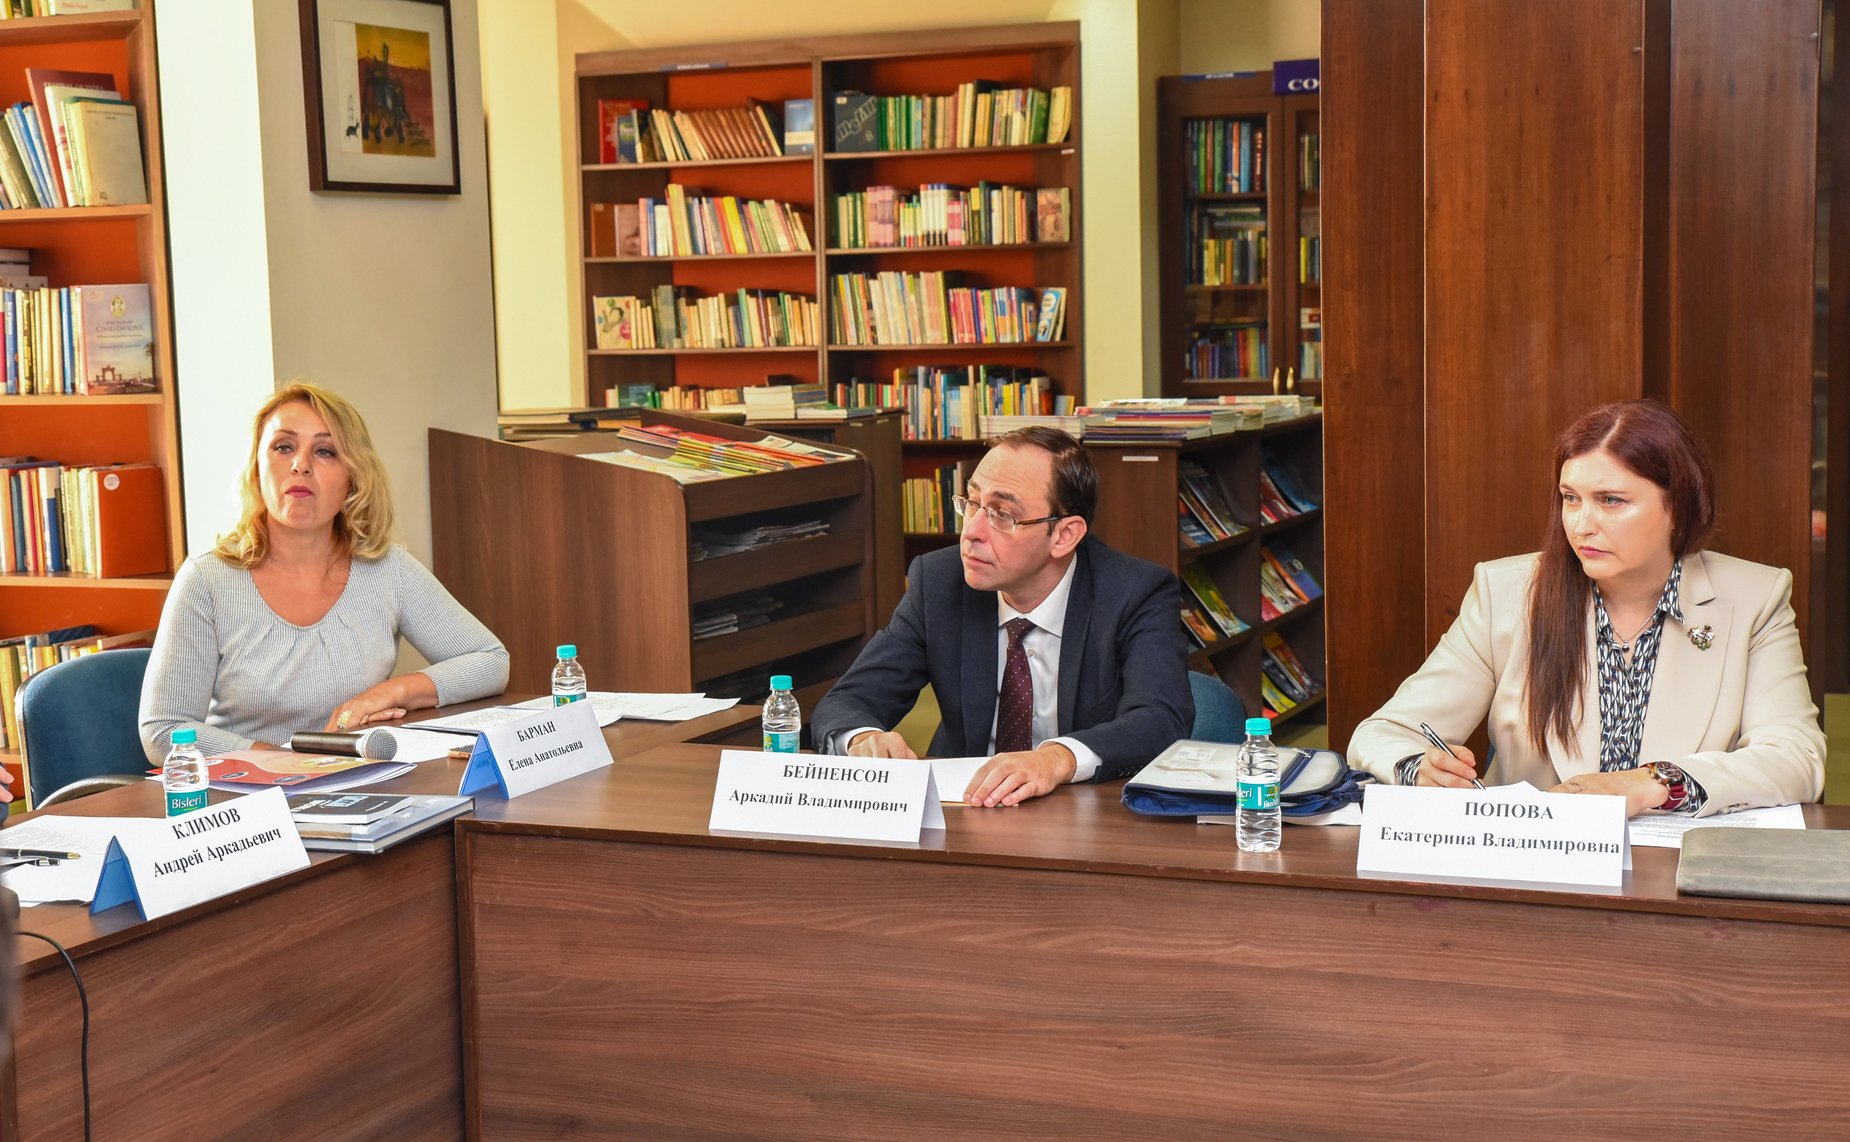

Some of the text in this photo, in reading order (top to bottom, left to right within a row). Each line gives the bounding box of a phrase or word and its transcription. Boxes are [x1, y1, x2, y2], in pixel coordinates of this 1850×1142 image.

[516, 721, 556, 742] БАРМАН
[508, 739, 584, 771] Елена Анатольевна
[783, 763, 890, 784] БЕЙНЕНСОН
[171, 795, 203, 809] Bisleri
[729, 788, 908, 813] Аркадий Владимирович
[1464, 801, 1554, 820] ПОПОВА
[172, 808, 242, 840] КЛИМОВ
[153, 827, 282, 878] Андрей Аркадьевич
[1380, 826, 1620, 854] Екатерина Владимировна
